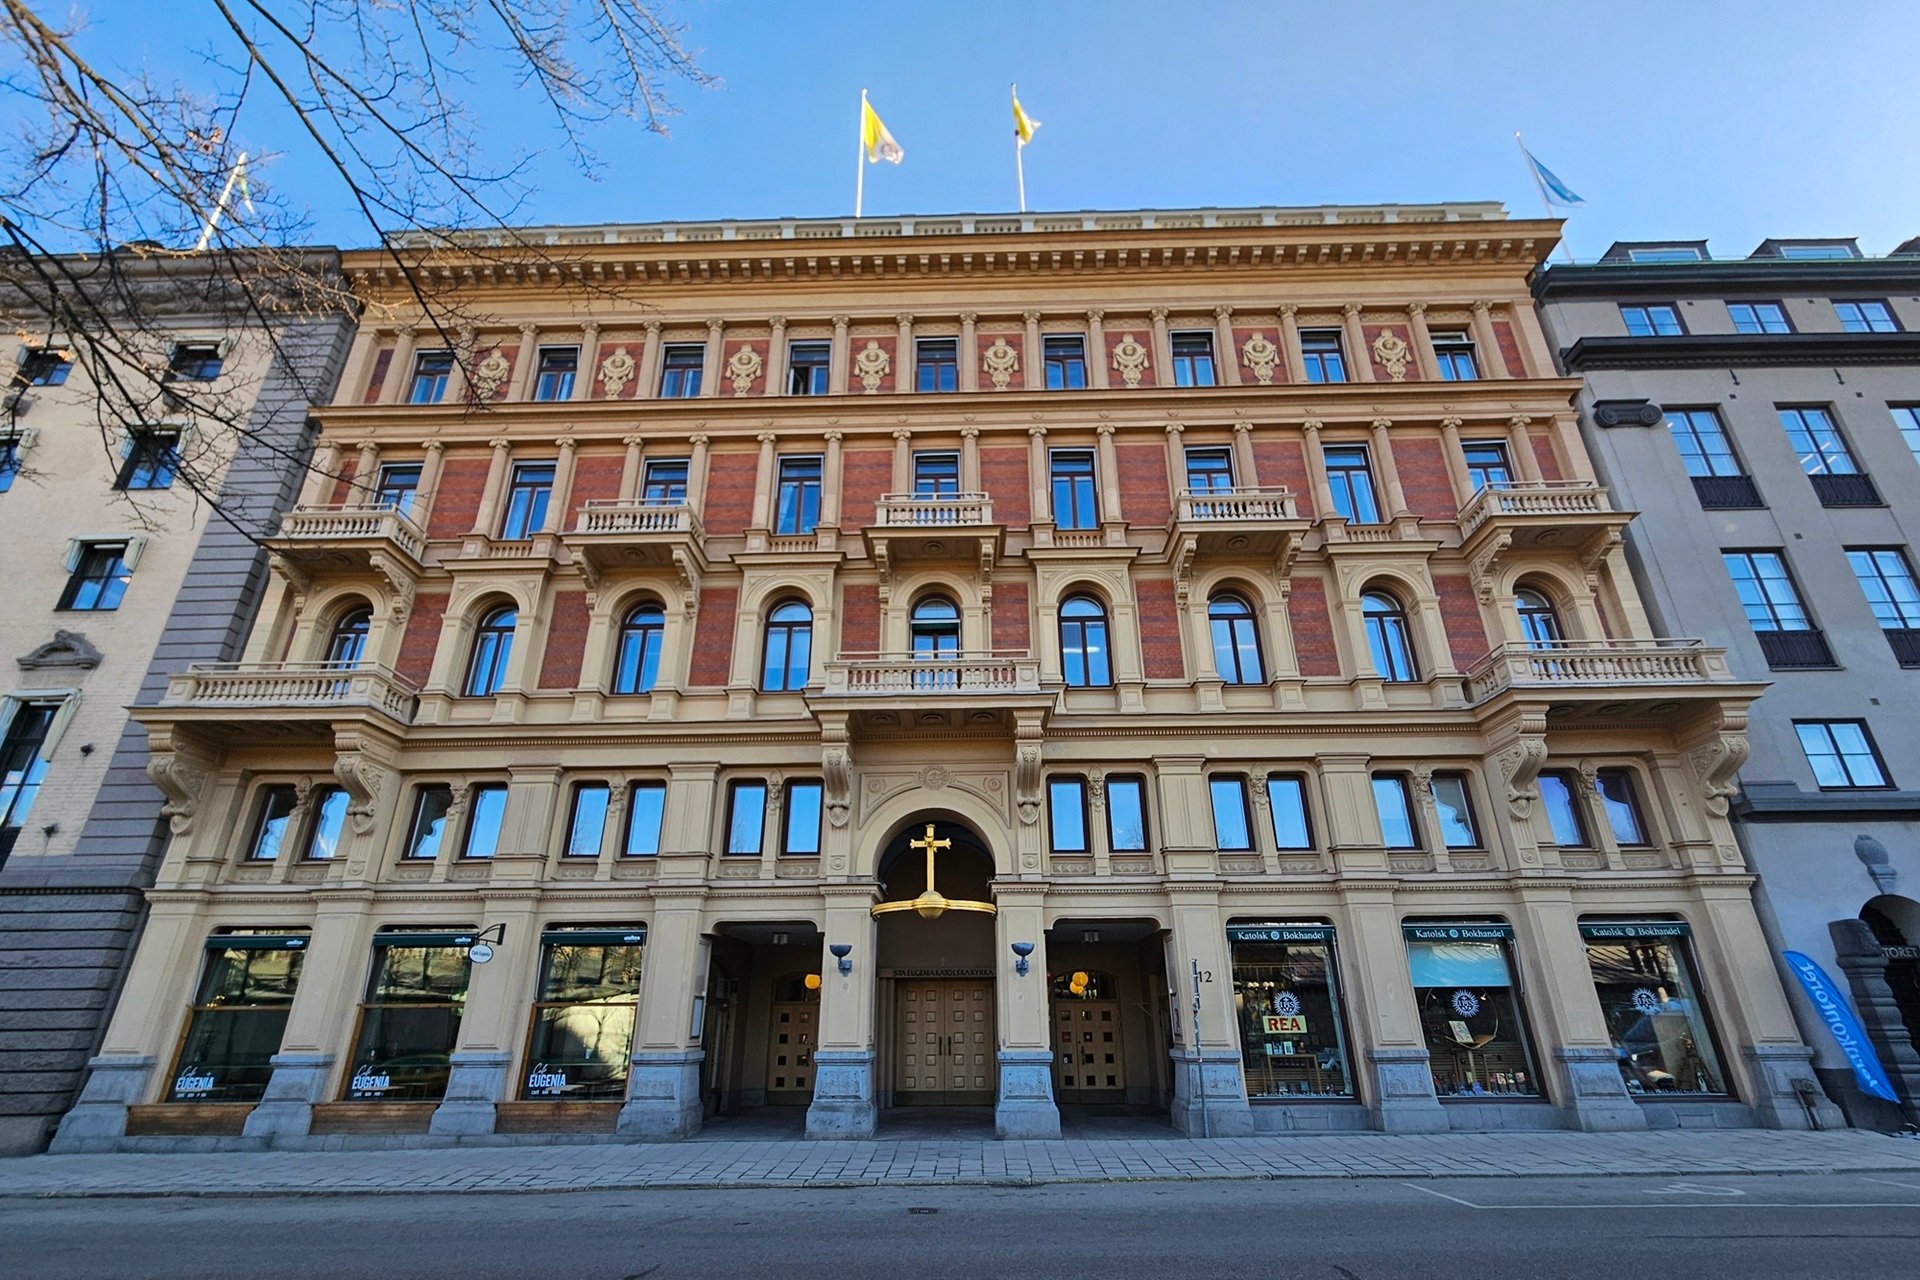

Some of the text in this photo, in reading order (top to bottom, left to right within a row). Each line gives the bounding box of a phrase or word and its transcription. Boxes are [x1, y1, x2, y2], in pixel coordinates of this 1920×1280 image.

[1237, 931, 1324, 940] Katolsk Bokhandel
[1415, 929, 1504, 938] Katolsk Bokhandel
[1591, 927, 1681, 936] Katolsk Bokhandel
[1198, 970, 1213, 983] 12
[1267, 1017, 1301, 1031] REA
[175, 1077, 215, 1090] EUGENIA
[352, 1075, 390, 1089] EUGENIA
[529, 1074, 566, 1087] EUGENIA
